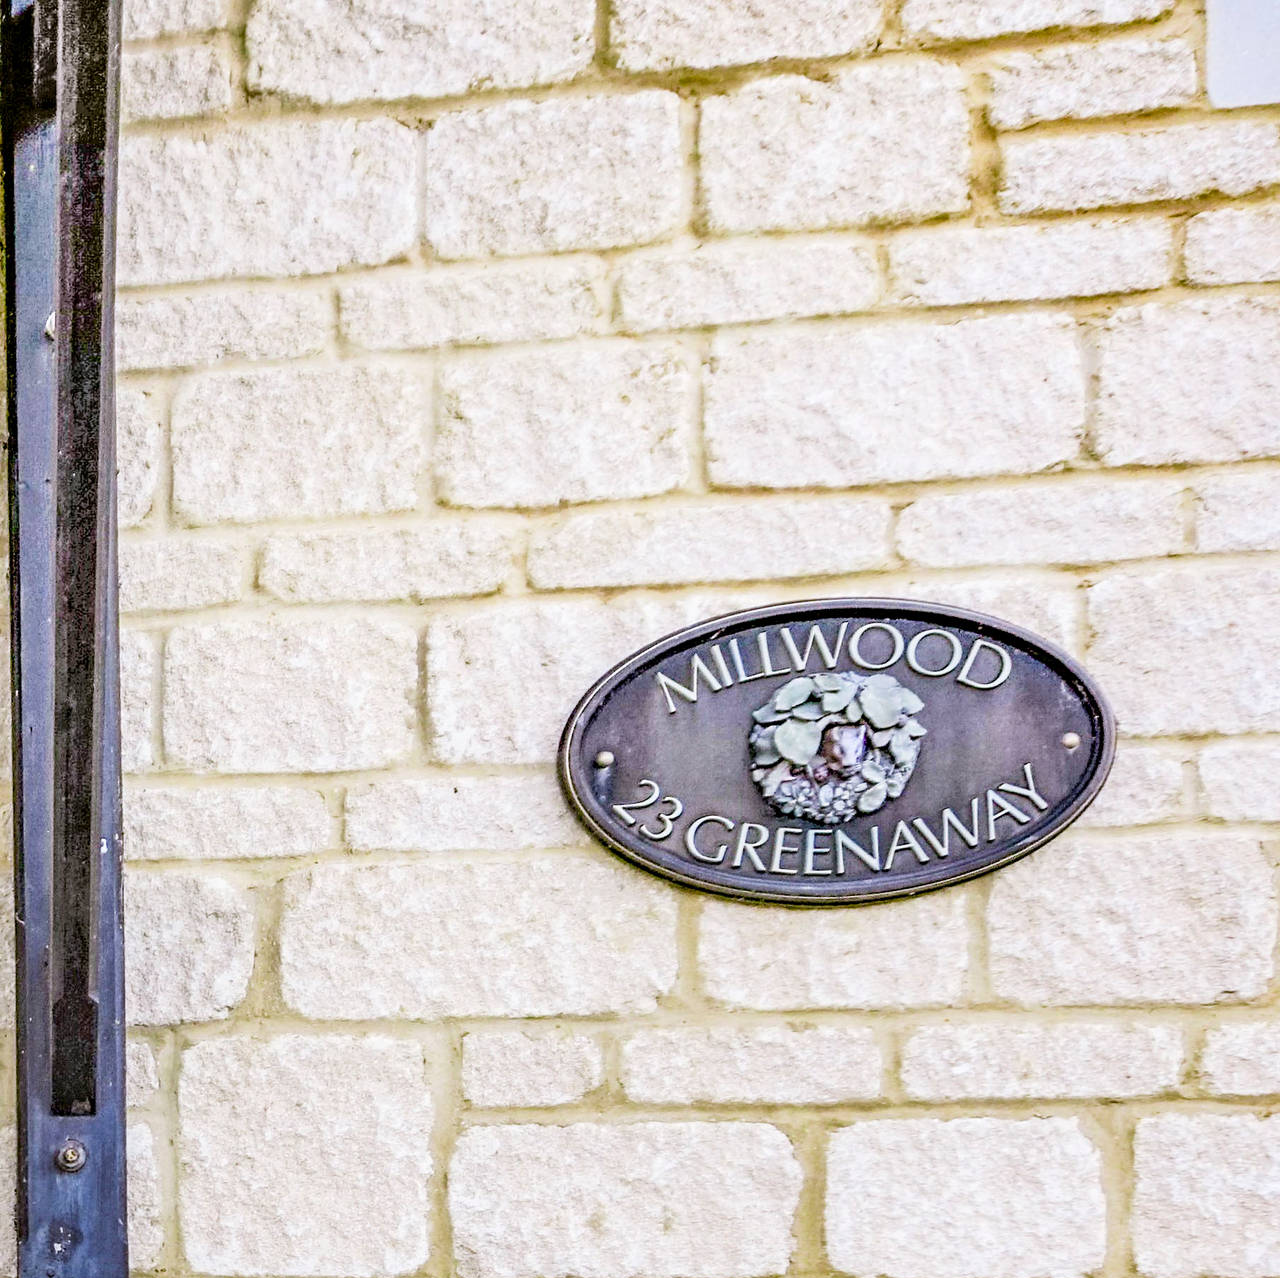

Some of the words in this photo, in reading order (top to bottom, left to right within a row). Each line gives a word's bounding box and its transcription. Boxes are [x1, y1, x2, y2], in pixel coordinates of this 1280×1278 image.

[655, 621, 1013, 714] MILLWOOD
[612, 779, 684, 841] 23
[685, 762, 1049, 876] GREENAWAY
